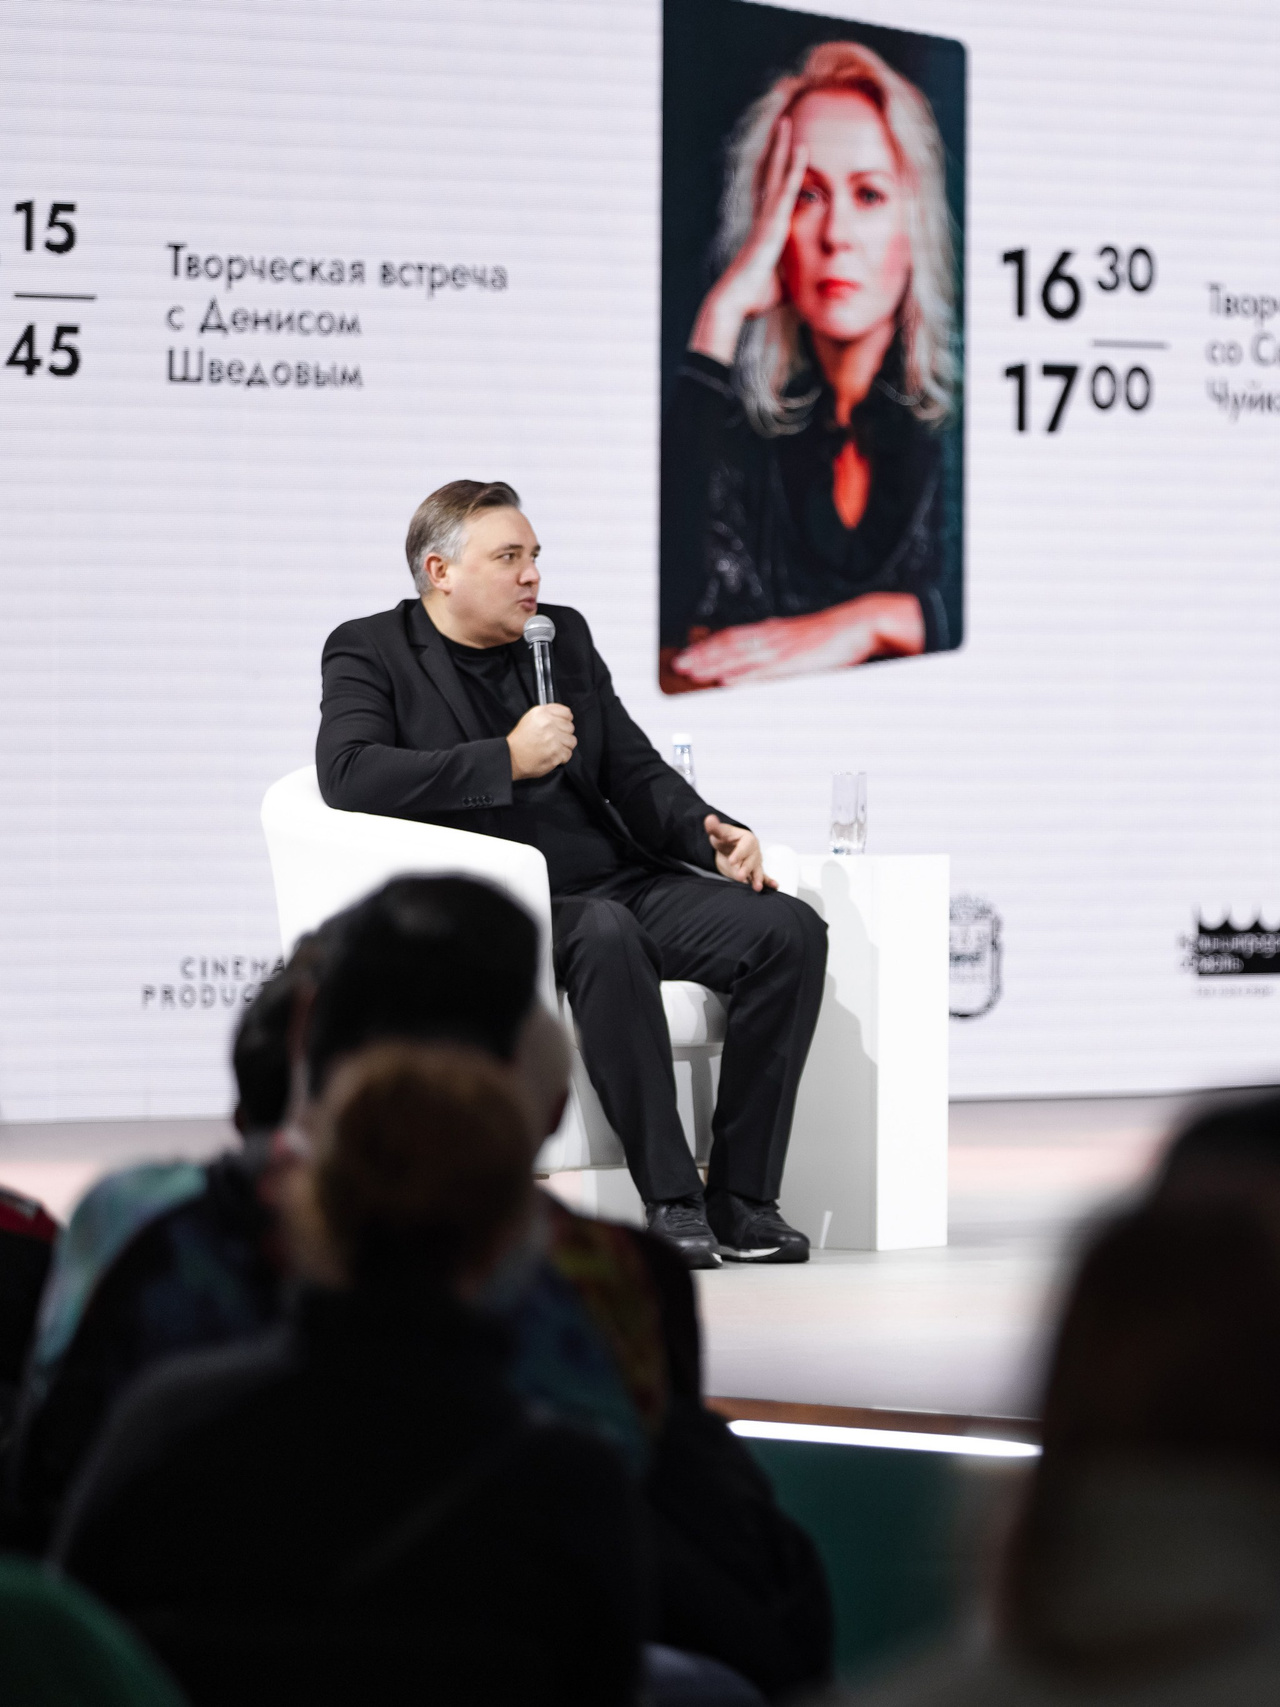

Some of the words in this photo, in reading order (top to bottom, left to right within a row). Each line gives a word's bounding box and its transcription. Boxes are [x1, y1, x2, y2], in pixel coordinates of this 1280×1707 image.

[13, 199, 77, 255] 15
[166, 242, 366, 291] Творческая
[379, 260, 509, 299] встреча
[165, 304, 186, 333] с
[198, 297, 364, 337] Денисом
[5, 322, 81, 378] 45
[166, 346, 364, 389] Шведовым
[1204, 339, 1244, 367] со
[180, 956, 285, 981] CINEMA
[142, 983, 262, 1010] PRODUC
